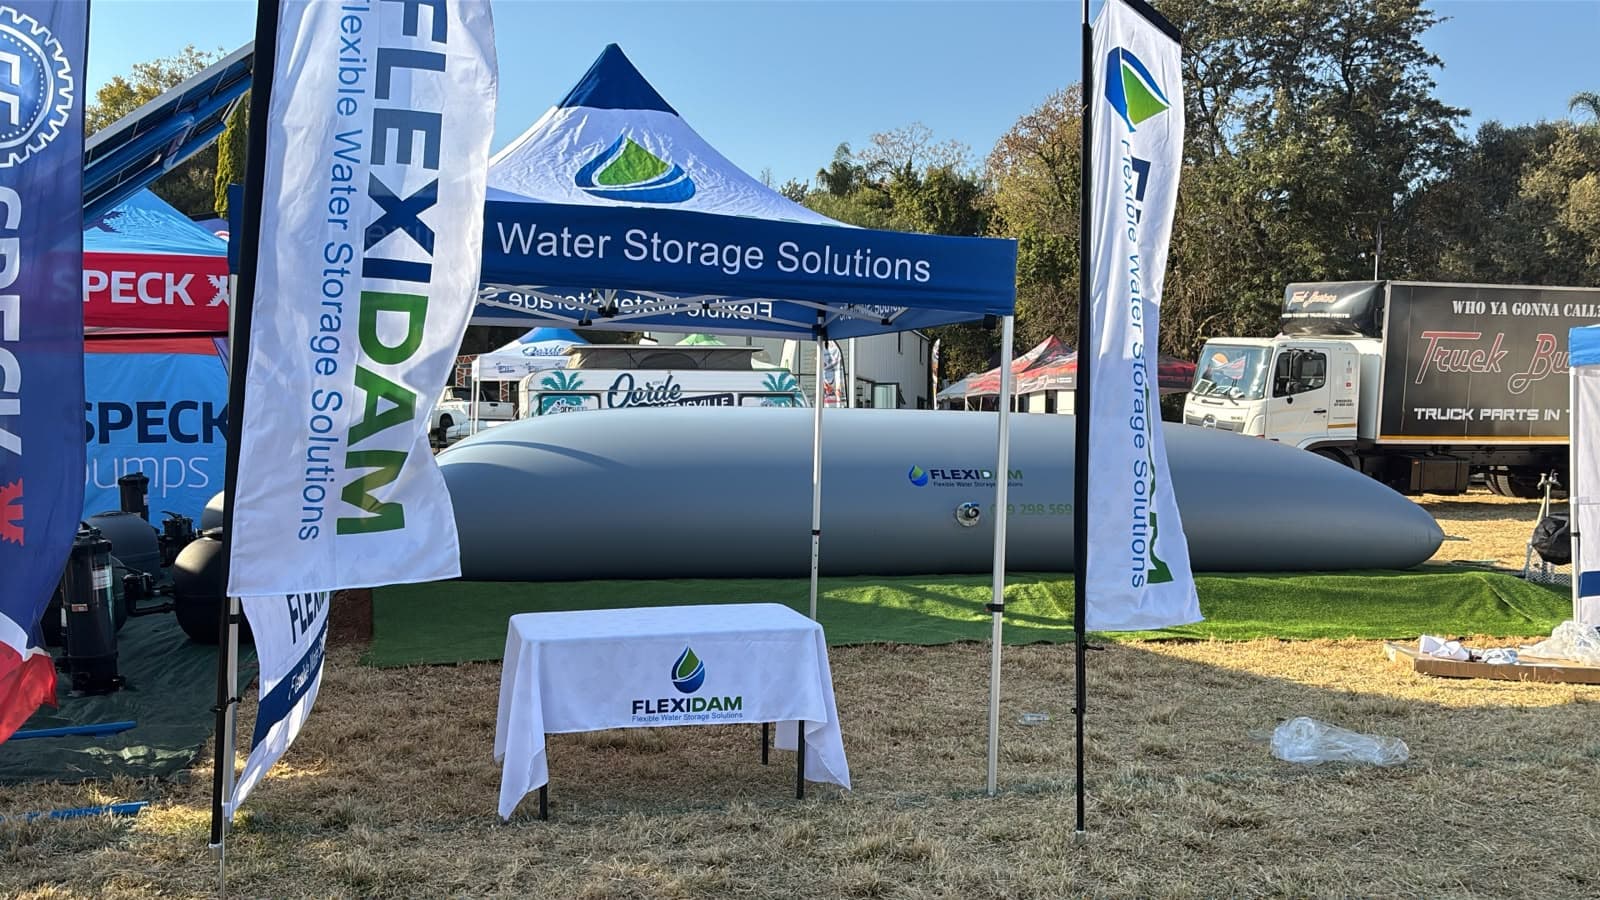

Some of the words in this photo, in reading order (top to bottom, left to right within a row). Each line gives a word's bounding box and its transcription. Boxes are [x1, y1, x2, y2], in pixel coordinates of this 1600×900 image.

[336, 0, 370, 117] lexible
[324, 129, 362, 231] Water
[336, 0, 448, 536] FLEXIDAM
[497, 222, 611, 260] Water
[624, 228, 763, 276] Storage
[777, 241, 932, 283] Solutions
[310, 241, 354, 376] Storage
[1452, 300, 1486, 315] WHO
[1490, 302, 1508, 316] YA
[1511, 302, 1560, 317] GONNA
[607, 372, 683, 409] Oorde
[1415, 330, 1508, 385] Truck
[1507, 333, 1570, 395] Bu
[1413, 407, 1474, 421] TRUCK
[1479, 408, 1539, 421] PARTS
[1543, 409, 1561, 421] IN
[86, 456, 209, 498] umps
[298, 388, 343, 541] Solutions
[929, 469, 1023, 480] FLEXIDM
[1131, 458, 1147, 589] Solutions
[632, 696, 743, 714] FLEXIDAM
[683, 713, 710, 722] Storage
[711, 711, 743, 720] Solutions
